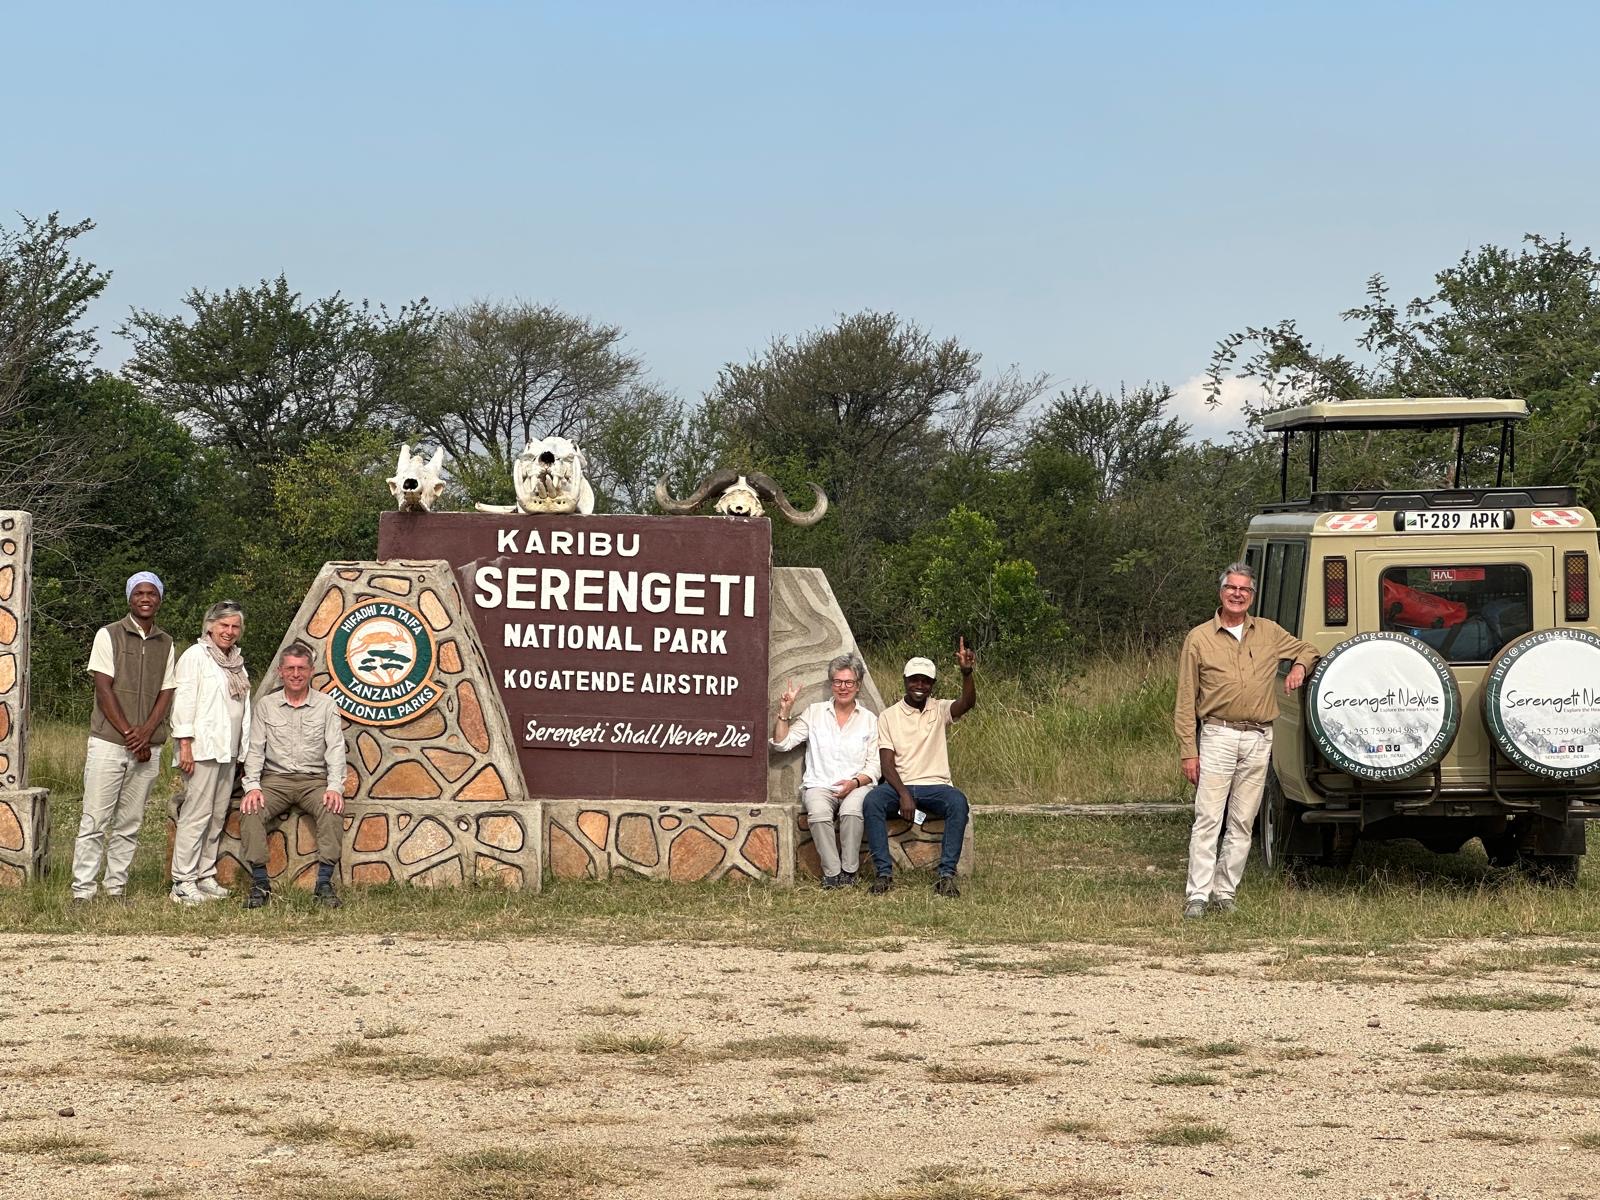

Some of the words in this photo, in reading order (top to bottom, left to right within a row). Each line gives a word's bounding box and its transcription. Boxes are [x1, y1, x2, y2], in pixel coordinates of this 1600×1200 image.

[1431, 513, 1461, 529] 289
[1469, 512, 1500, 528] APK
[497, 529, 640, 557] KARIBU
[1432, 571, 1454, 580] HAL
[474, 566, 756, 618] SERENGETI
[340, 604, 377, 633] HIFADHI
[379, 604, 395, 617] ZA
[397, 608, 423, 636] TAIFA
[504, 623, 643, 652] NATIONAL
[653, 628, 728, 655] PARK
[348, 677, 417, 700] TANZANIA
[504, 668, 635, 694] KOGATENDE
[640, 672, 739, 696] AIRSTRIP
[328, 687, 395, 720] NATIONAL
[397, 688, 433, 717] PARKS
[1323, 688, 1396, 713] Serengeti
[1506, 688, 1580, 713] Serengeti
[525, 719, 610, 747] Serengeti
[610, 722, 664, 745] Shall
[660, 723, 718, 749] Never
[715, 724, 751, 748] Die
[1370, 726, 1386, 735] 759
[1553, 727, 1569, 736] 759
[1318, 731, 1446, 780] www.serengetinexus.com
